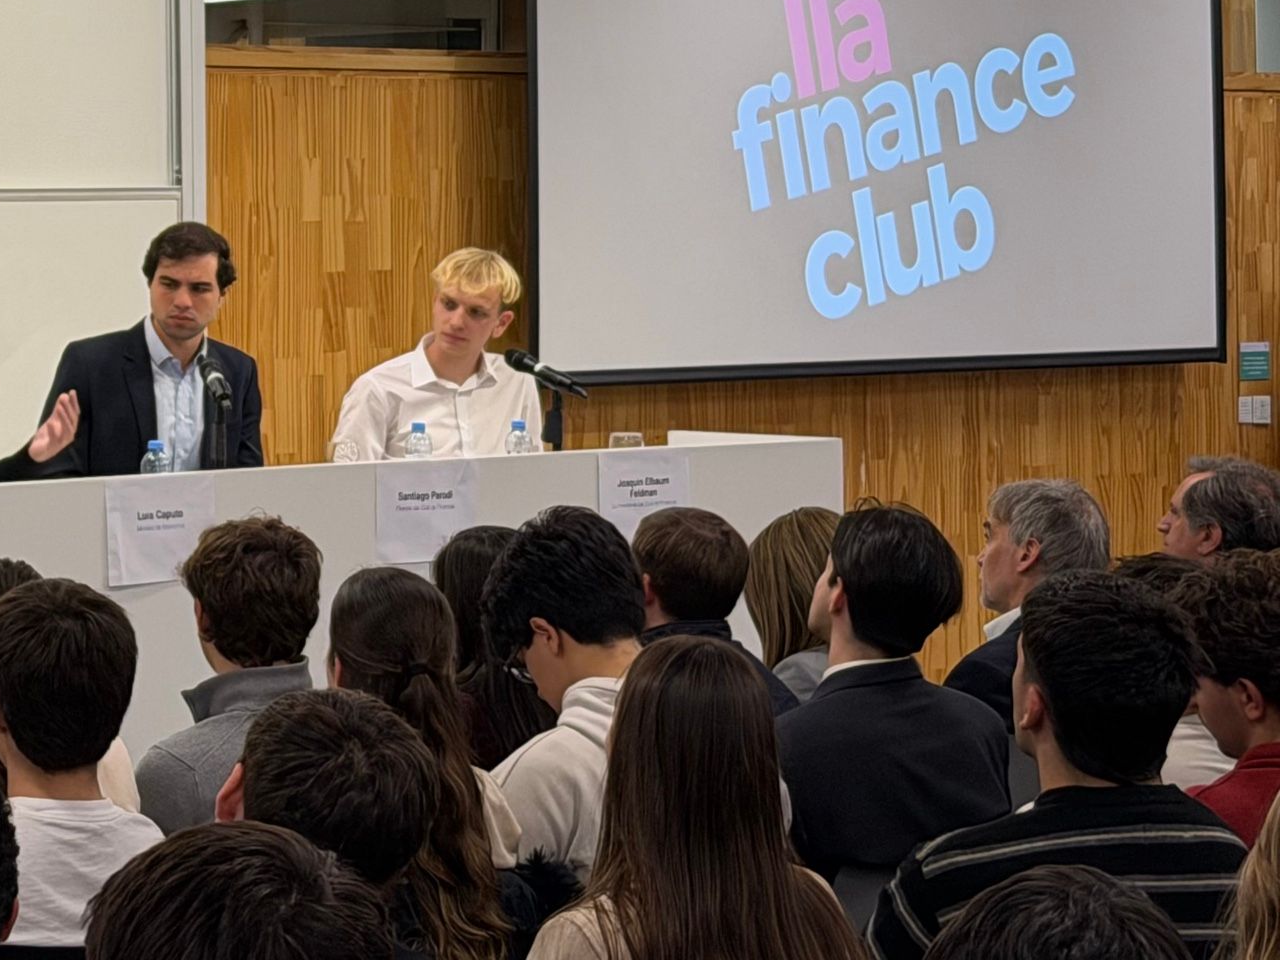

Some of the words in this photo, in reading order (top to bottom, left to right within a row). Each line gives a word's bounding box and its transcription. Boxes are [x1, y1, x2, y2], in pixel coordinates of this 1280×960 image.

[731, 32, 1076, 212] finance
[804, 162, 996, 320] club
[155, 510, 184, 520] Caputo
[398, 491, 429, 502] Santiago
